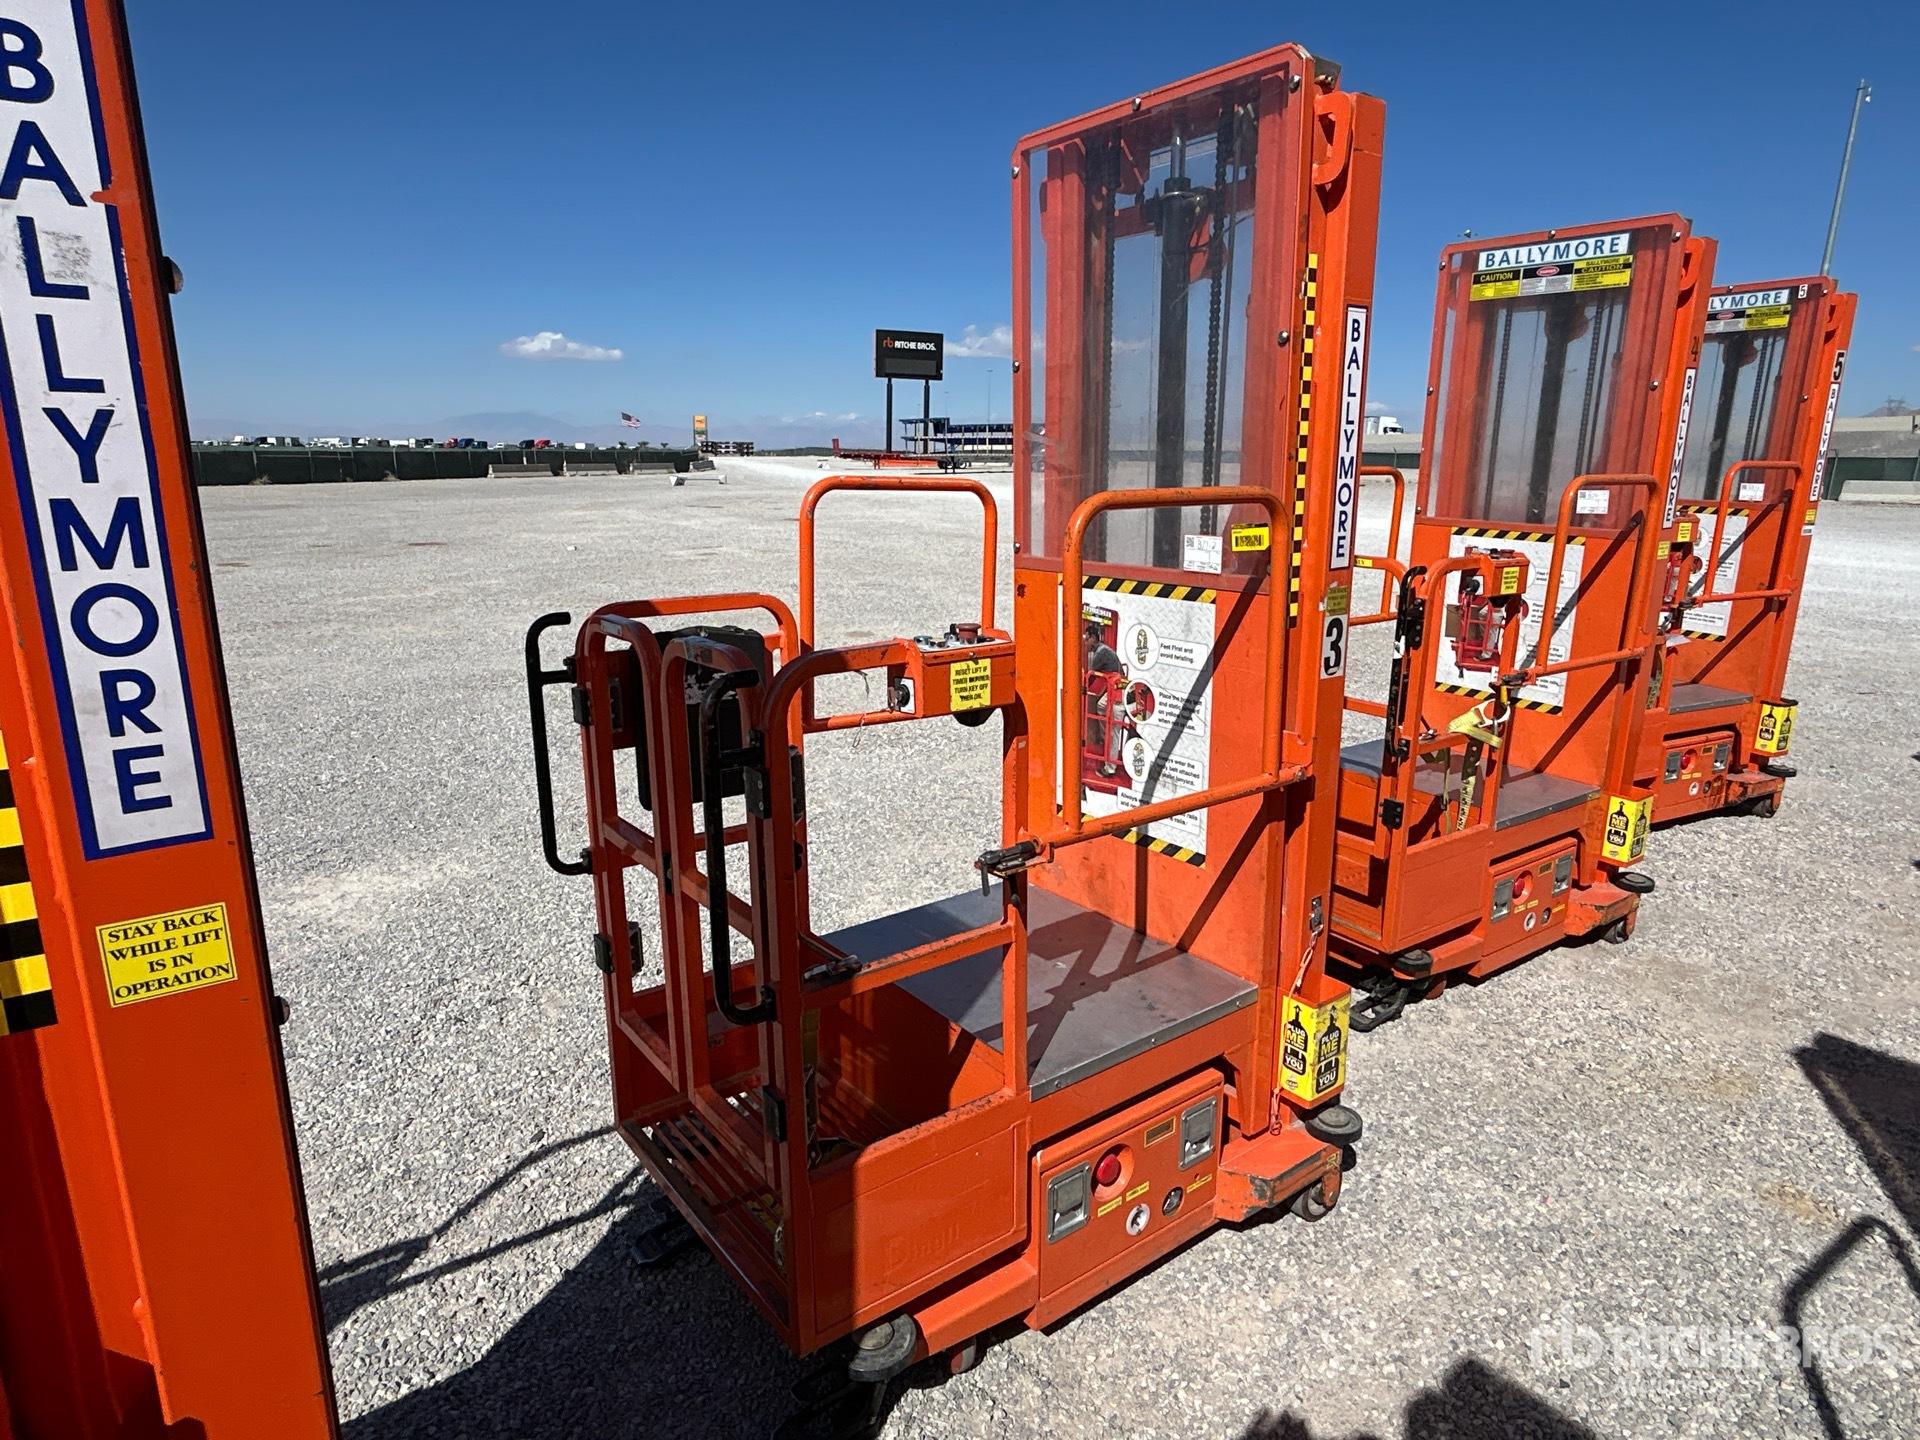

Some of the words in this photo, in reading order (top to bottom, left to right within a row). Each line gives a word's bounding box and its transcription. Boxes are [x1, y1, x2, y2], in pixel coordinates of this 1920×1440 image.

[1485, 237, 1620, 268] BALLYMORE
[1480, 272, 1513, 283] CAUTION
[1581, 264, 1623, 274] CAUTION
[1709, 291, 1783, 310] LYMORE
[1799, 285, 1806, 298] 5
[894, 340, 917, 349] RITCHIE
[1833, 351, 1845, 381] 5
[0, 17, 173, 815] BALLYMORE
[1335, 318, 1361, 559] BALLYMORE
[1666, 375, 1692, 522] BALLYMORE
[1811, 388, 1836, 497] BALLYMORE
[1323, 617, 1344, 676] 3
[955, 668, 970, 676] RESET
[972, 666, 982, 674] LIFT
[107, 921, 157, 943] STAY
[162, 910, 220, 932] BACK
[108, 937, 178, 961] WHILE
[182, 927, 223, 947] LIFT
[147, 958, 166, 973] IS
[171, 952, 194, 968] IN
[115, 963, 231, 998] OPERATION
[1286, 1030, 1305, 1045] ME
[1321, 1030, 1339, 1044] PLUG
[1321, 1038, 1338, 1056] ME
[1285, 1055, 1303, 1071] YOU
[1319, 1071, 1336, 1087] YOU
